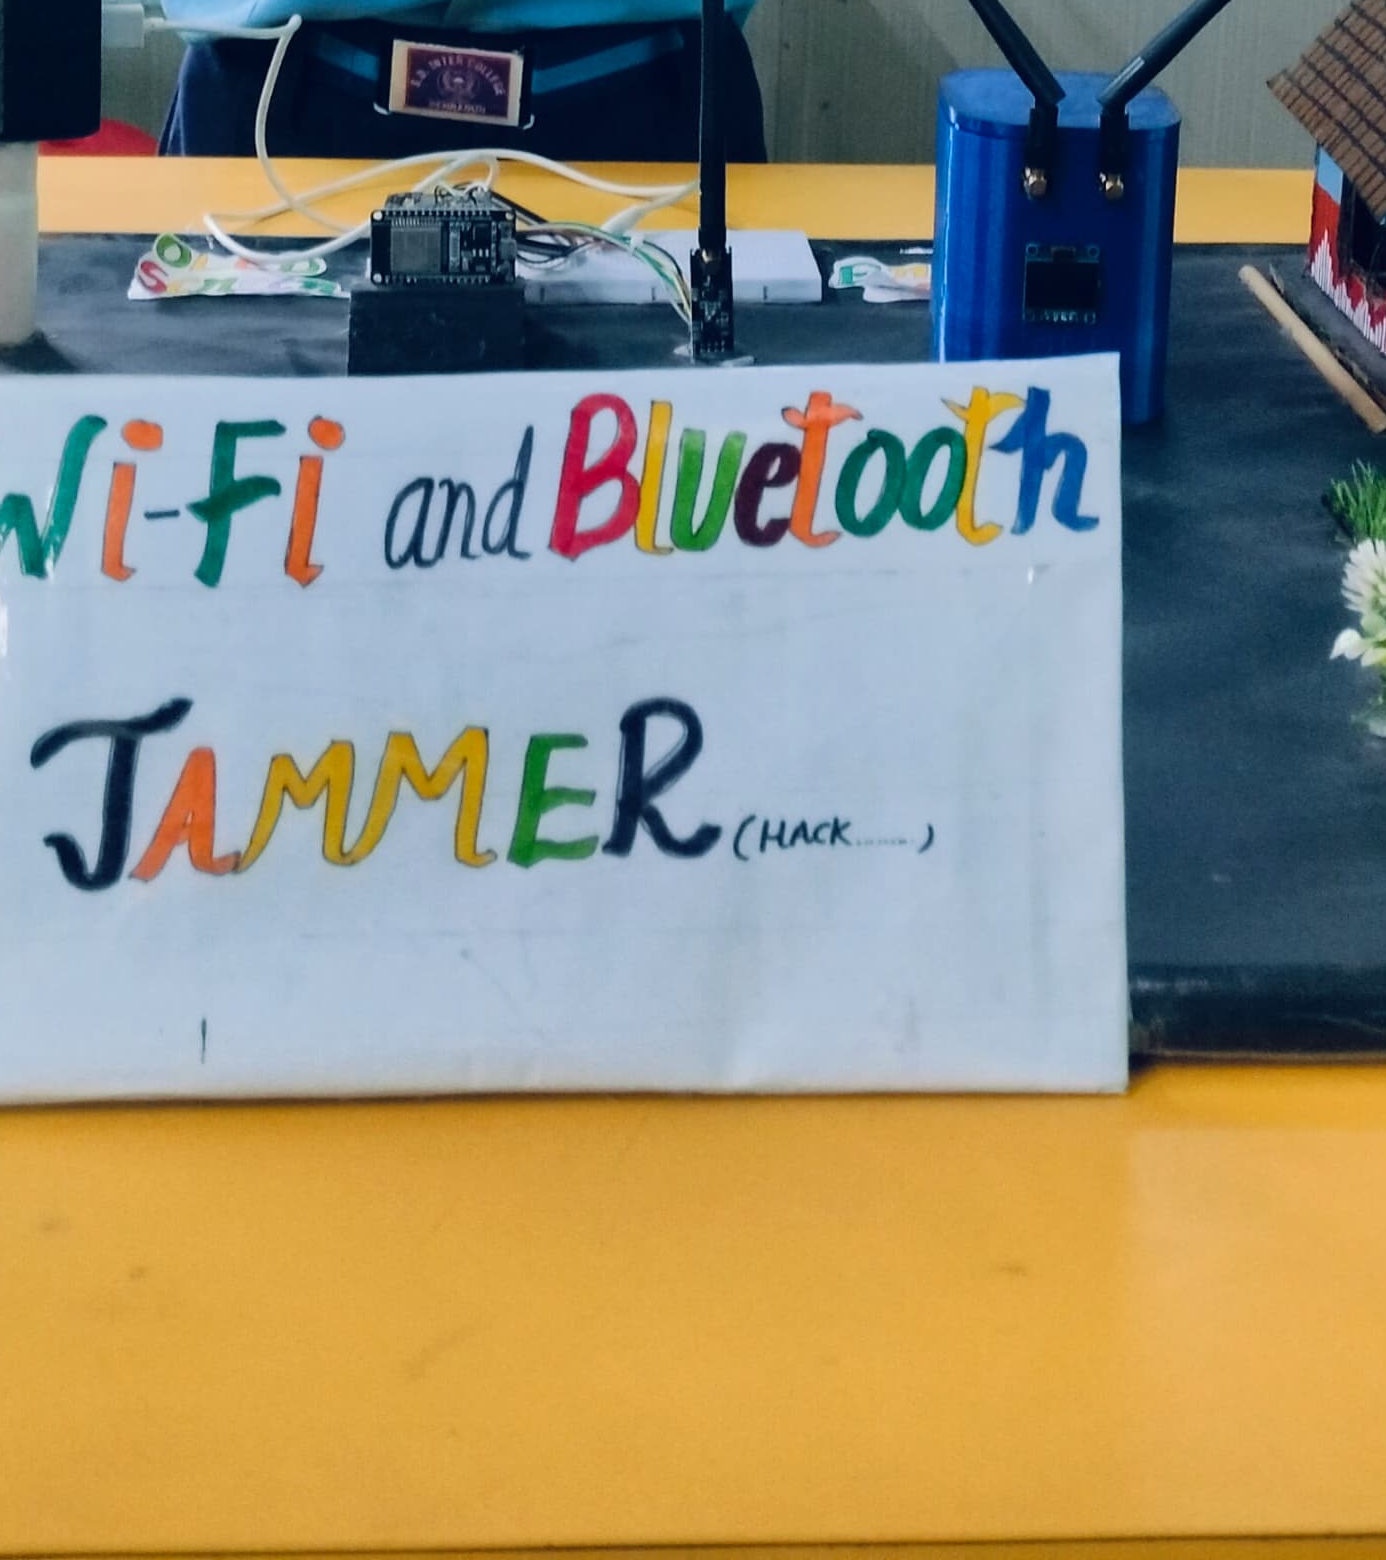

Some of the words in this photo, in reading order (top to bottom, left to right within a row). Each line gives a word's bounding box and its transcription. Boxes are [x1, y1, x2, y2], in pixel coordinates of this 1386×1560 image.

[383, 425, 535, 570] and
[548, 386, 1101, 563] Bluetooth
[29, 696, 722, 893] JAMMER
